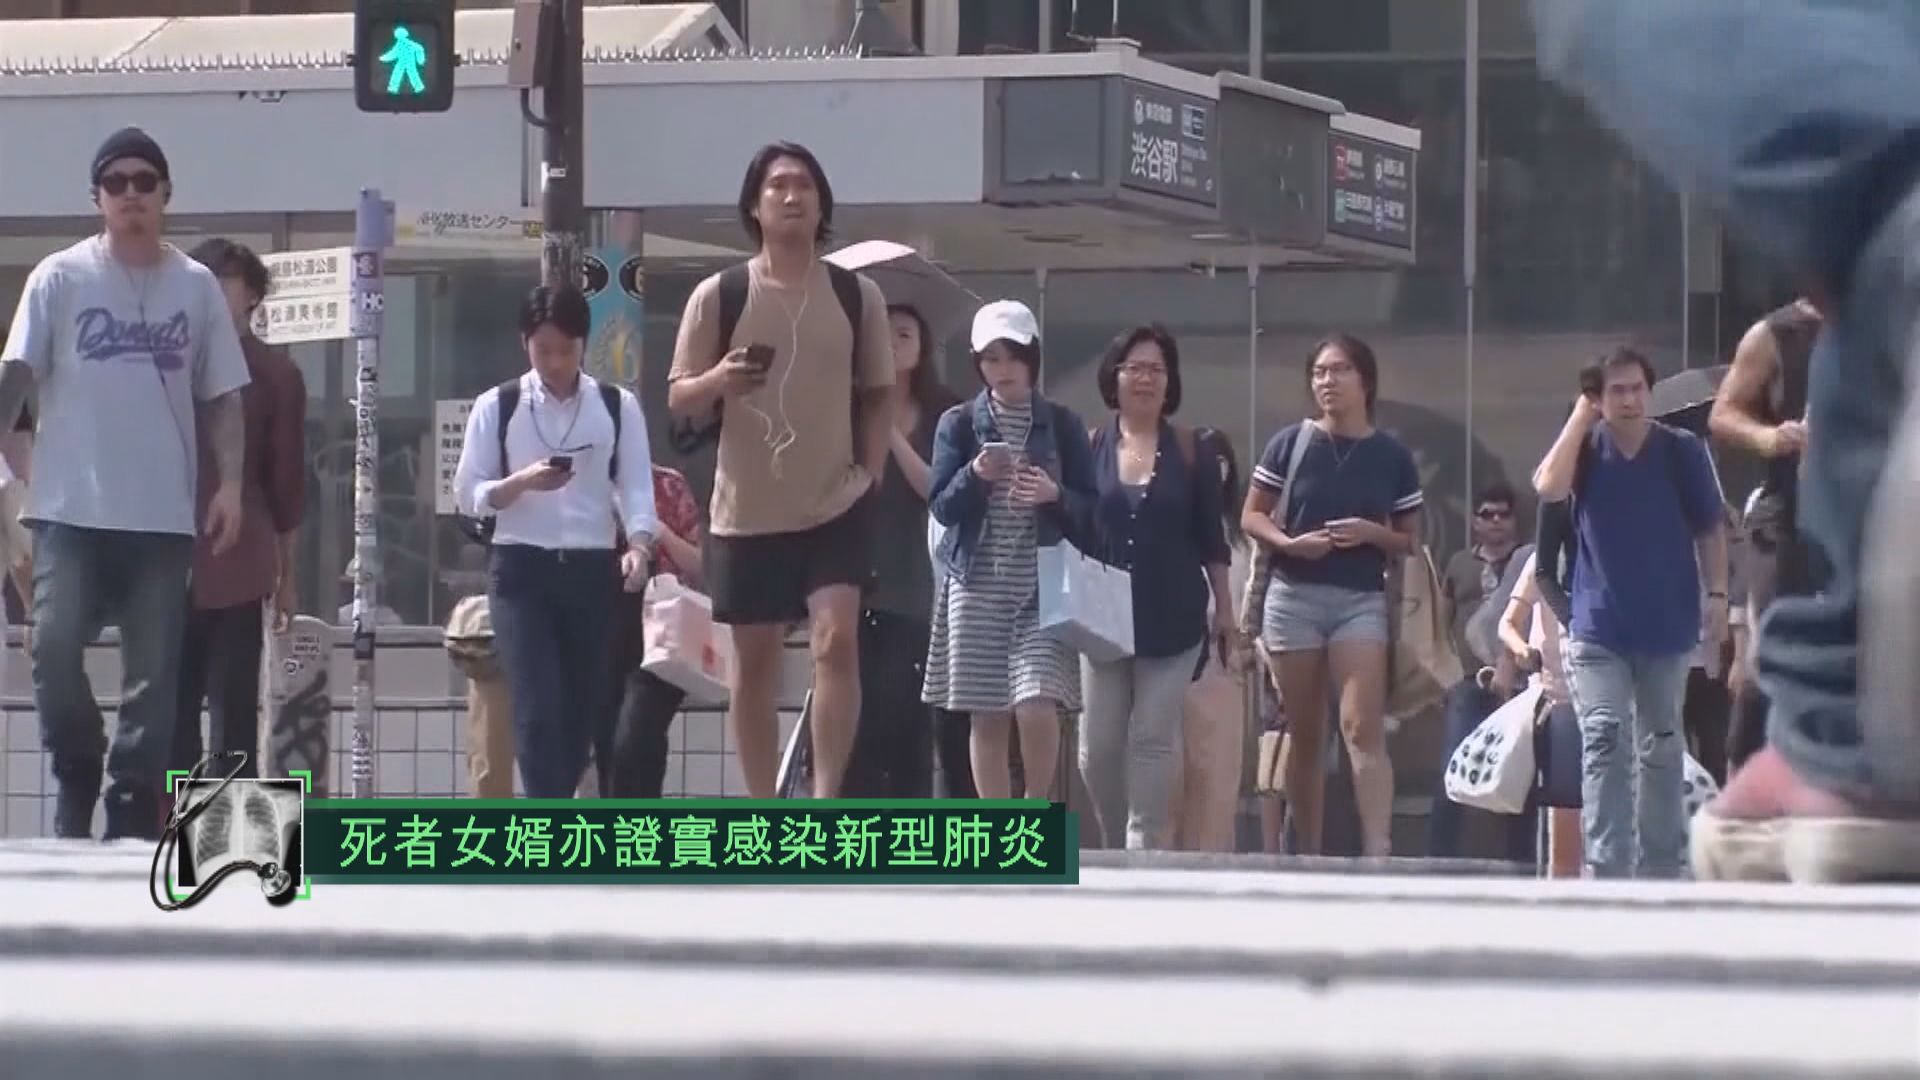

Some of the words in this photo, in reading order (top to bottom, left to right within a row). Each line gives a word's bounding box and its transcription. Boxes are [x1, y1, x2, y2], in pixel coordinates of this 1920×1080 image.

[1130, 131, 1178, 184] 渋谷駅
[76, 308, 190, 354] Donuts
